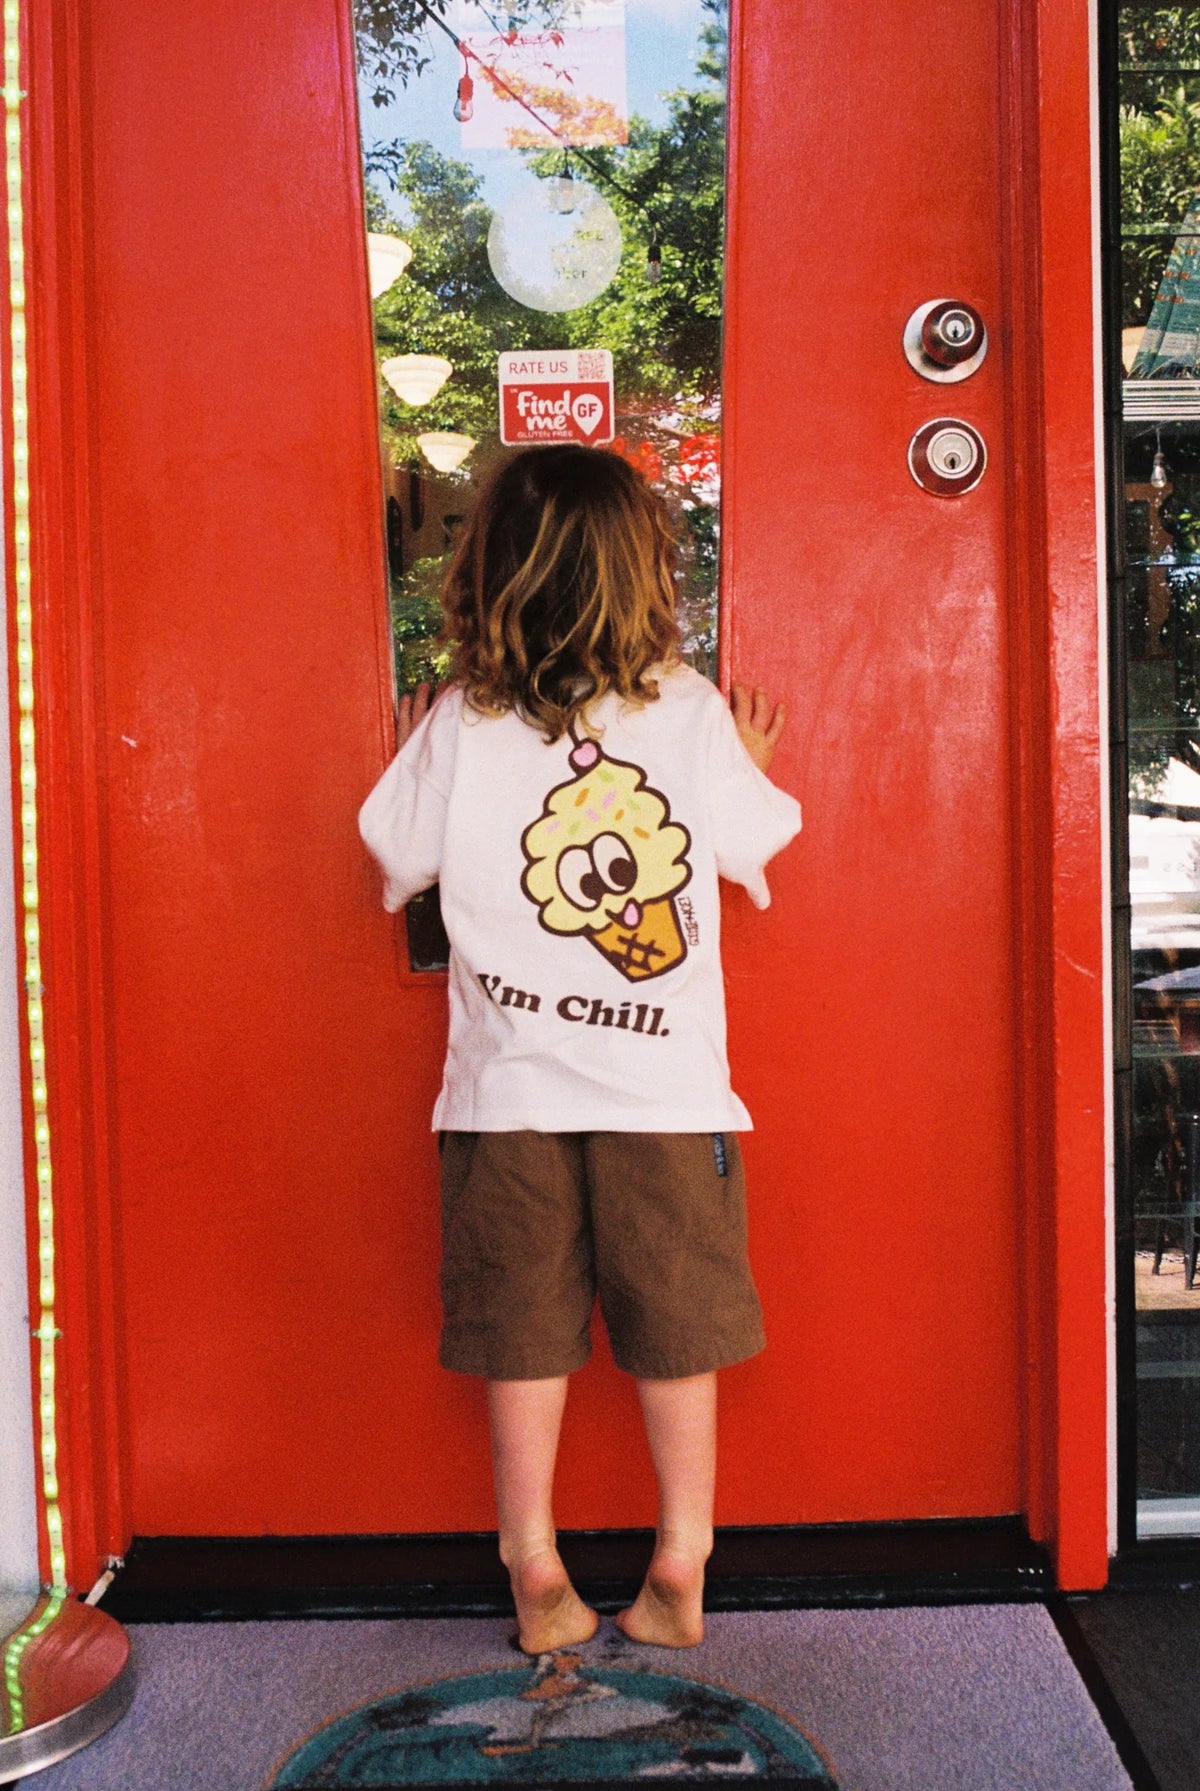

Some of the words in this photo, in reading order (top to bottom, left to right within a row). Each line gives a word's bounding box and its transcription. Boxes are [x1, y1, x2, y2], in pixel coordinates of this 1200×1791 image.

[509, 361, 545, 374] RATE
[549, 361, 568, 373] US
[577, 403, 597, 418] GF
[526, 415, 567, 431] me
